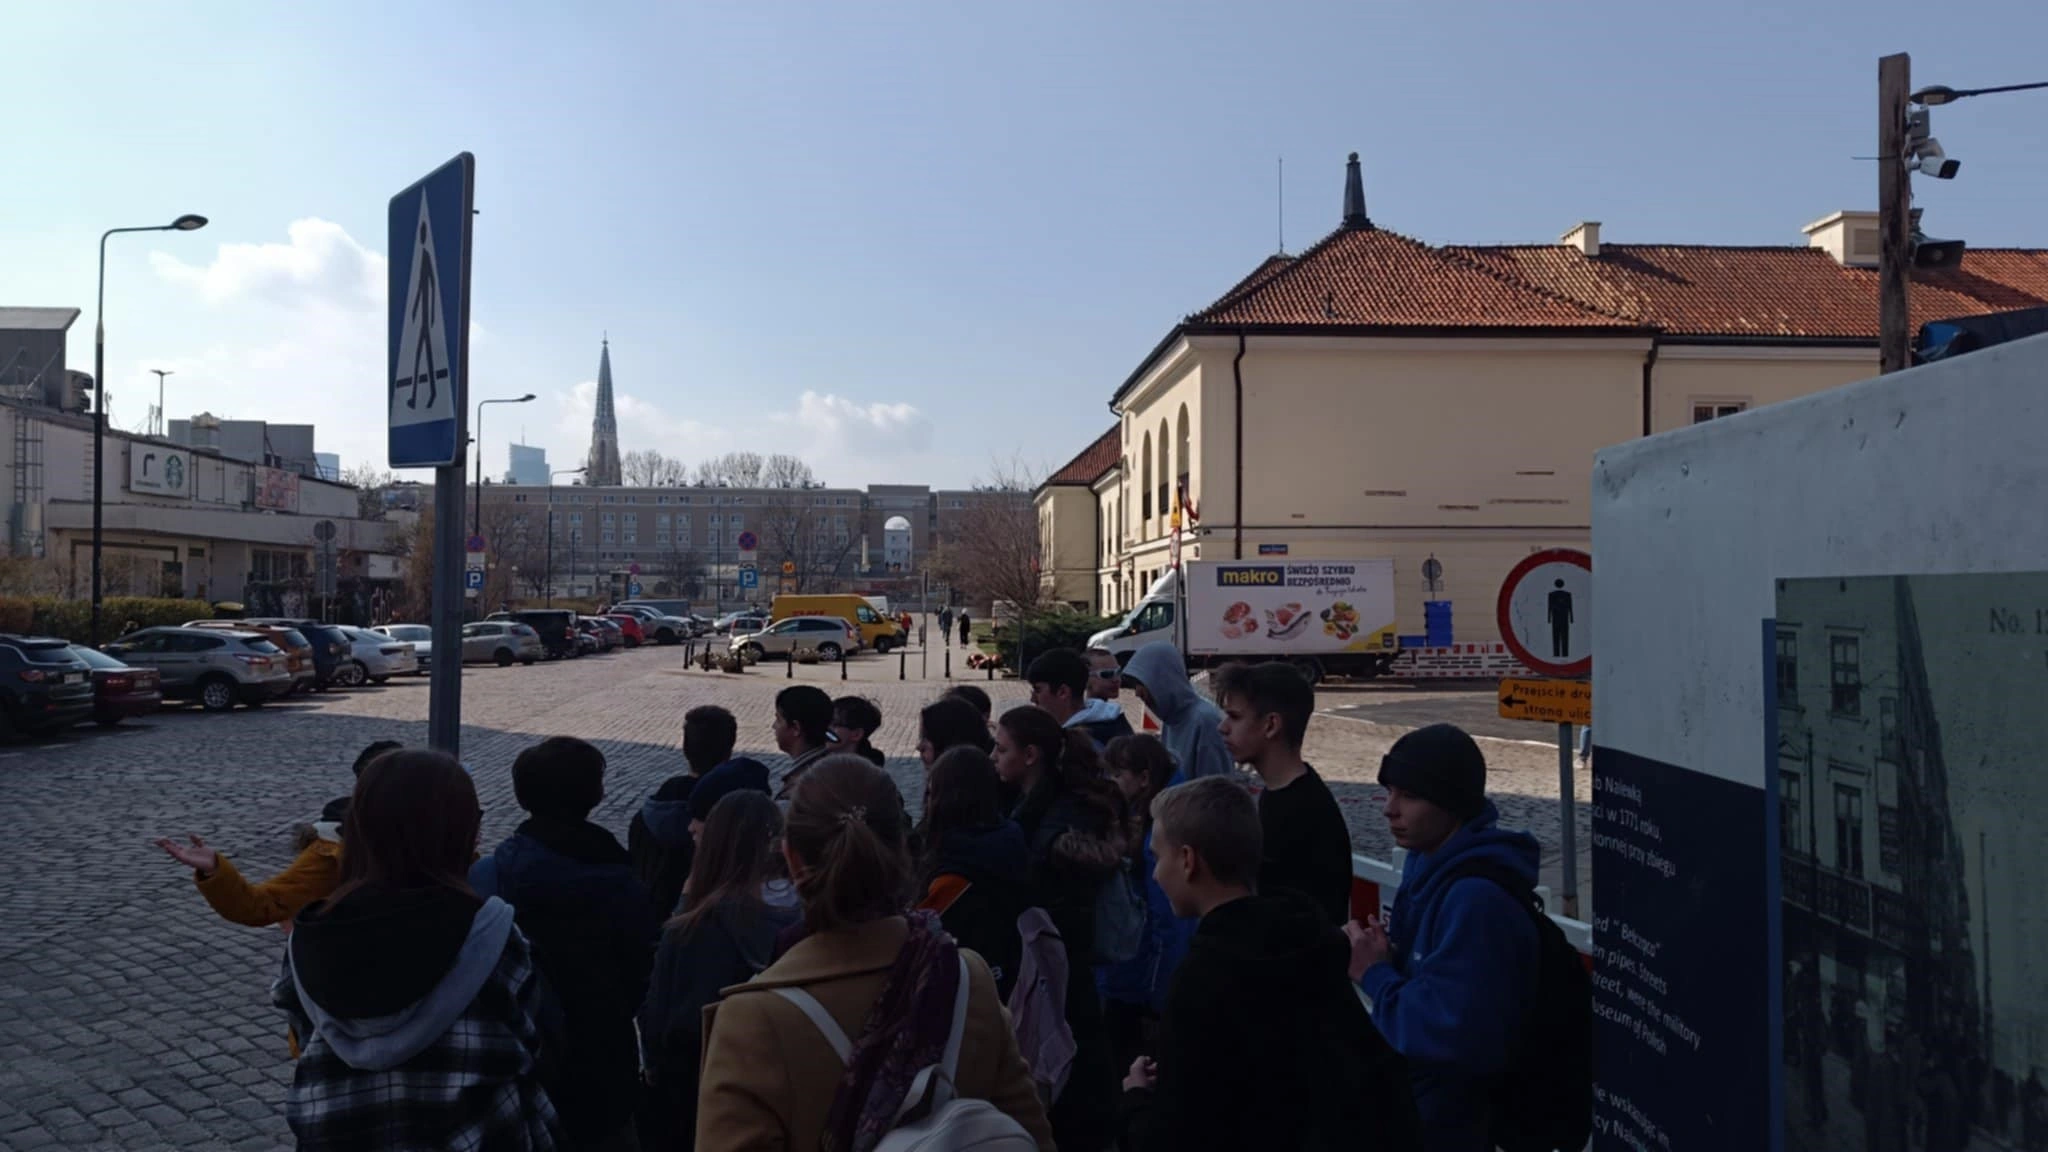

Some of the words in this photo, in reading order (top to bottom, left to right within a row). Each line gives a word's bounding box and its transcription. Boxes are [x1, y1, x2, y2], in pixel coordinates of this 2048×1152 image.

[469, 572, 481, 587] P
[743, 571, 755, 586] P
[1223, 569, 1280, 585] makro
[1322, 565, 1356, 575] SZYBKO
[1989, 607, 2025, 635] No.
[2035, 607, 2048, 635] 1
[1607, 807, 1617, 822] w
[1619, 808, 1639, 831] 1771
[1639, 962, 1668, 995] Streets
[1632, 1019, 1642, 1040] of
[1642, 1022, 1667, 1057] Polish
[1647, 999, 1661, 1022] the
[1662, 1013, 1701, 1051] military
